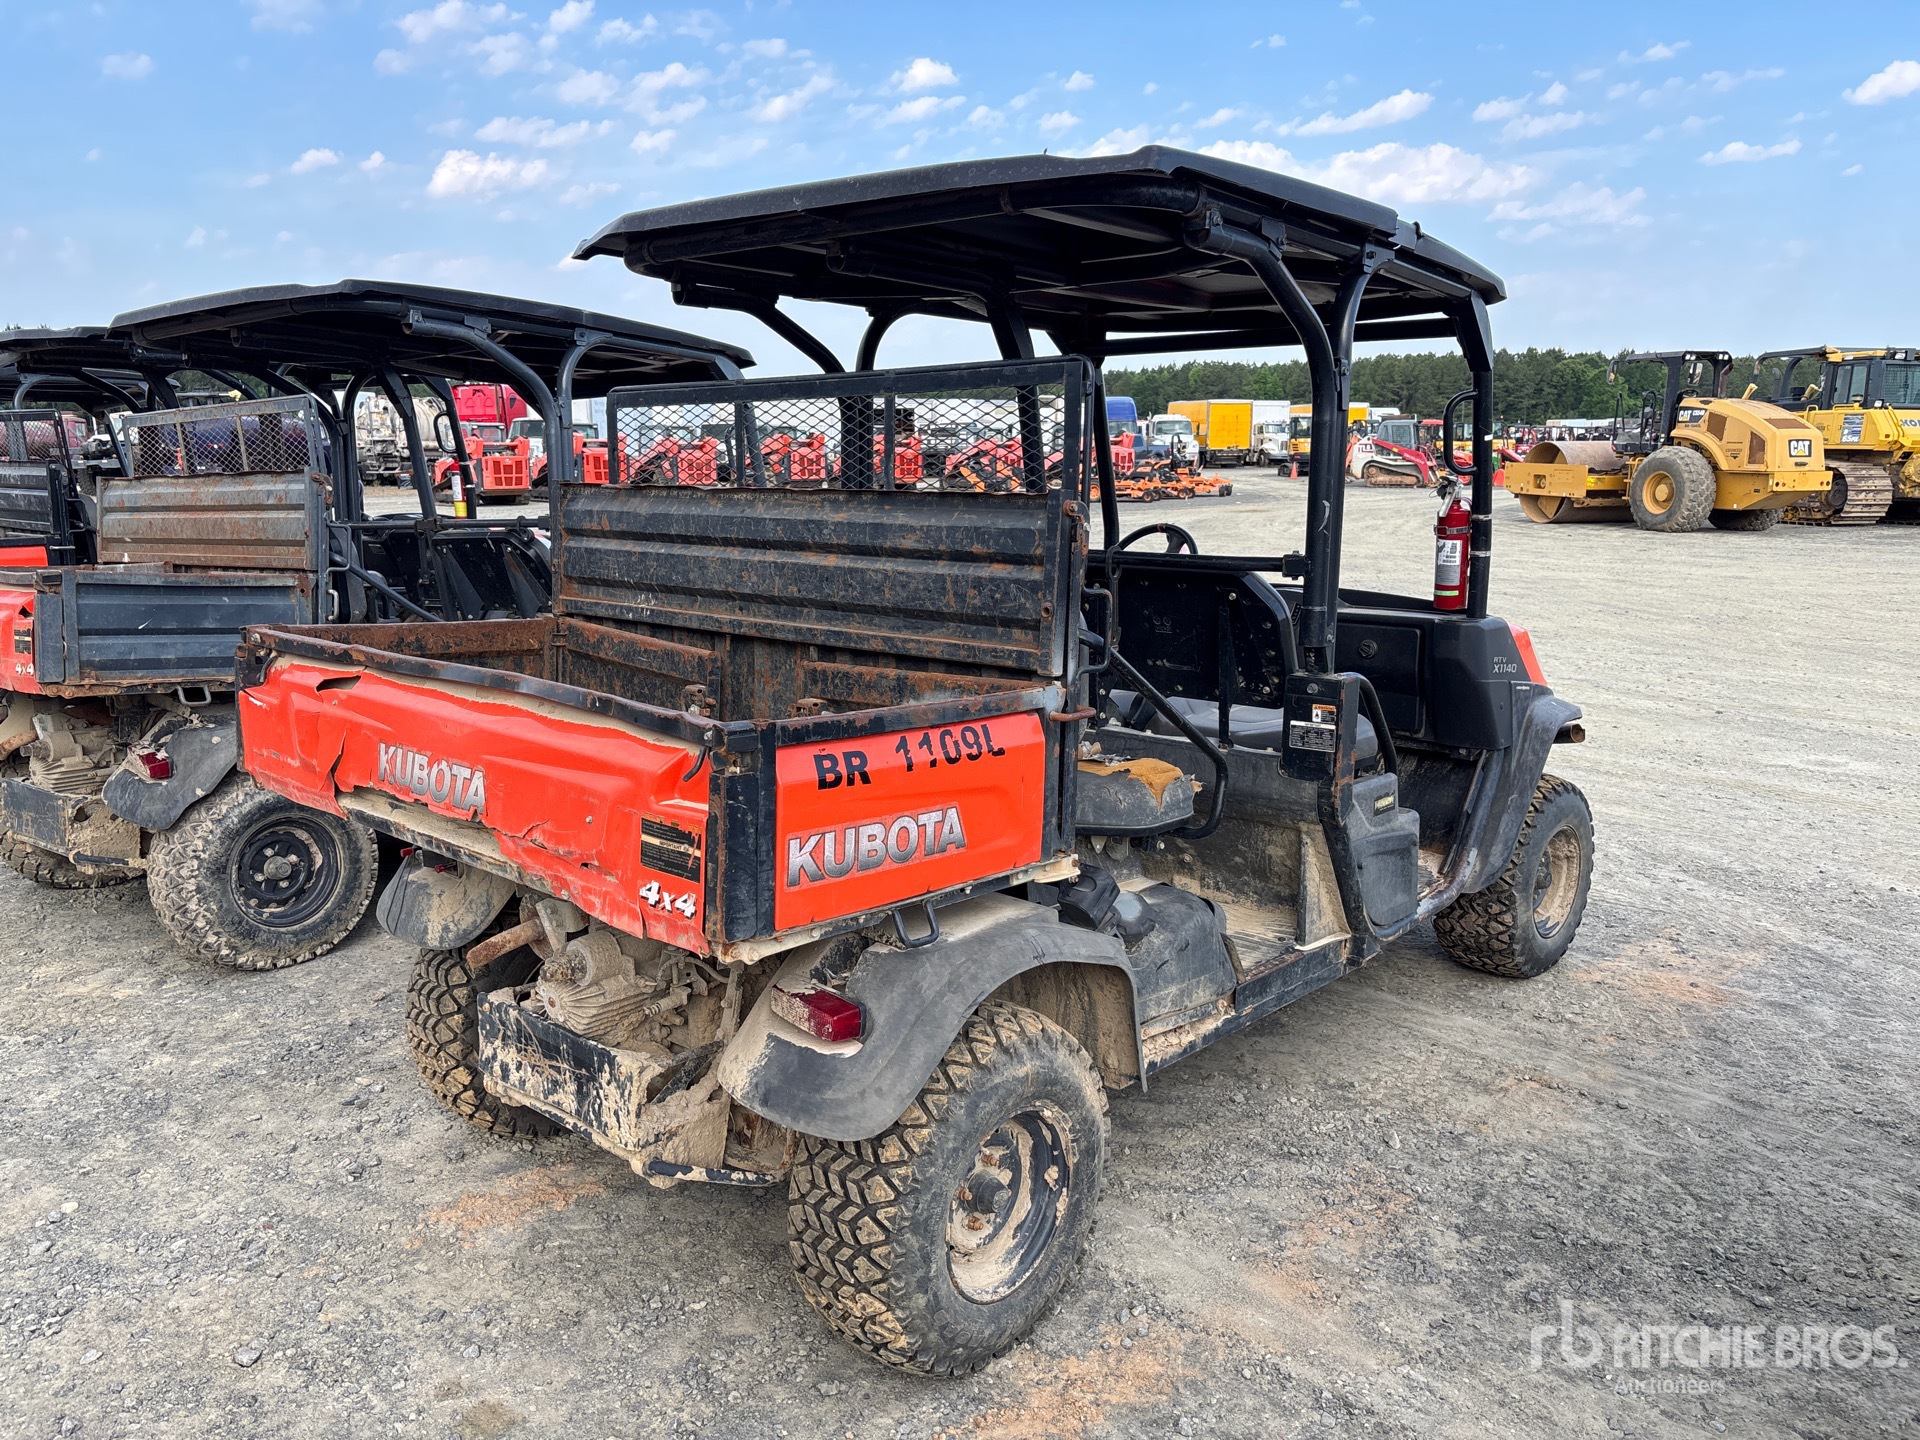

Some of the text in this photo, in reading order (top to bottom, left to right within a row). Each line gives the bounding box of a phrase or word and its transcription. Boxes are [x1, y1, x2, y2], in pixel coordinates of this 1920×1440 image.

[1678, 410, 1692, 421] CAT
[1790, 440, 1810, 456] CAT
[1492, 663, 1517, 673] X1140
[813, 723, 1006, 790] BR 1109L
[378, 742, 487, 815] KUBOTA
[787, 806, 967, 888] KUBOTA
[639, 880, 697, 918] 4x4
